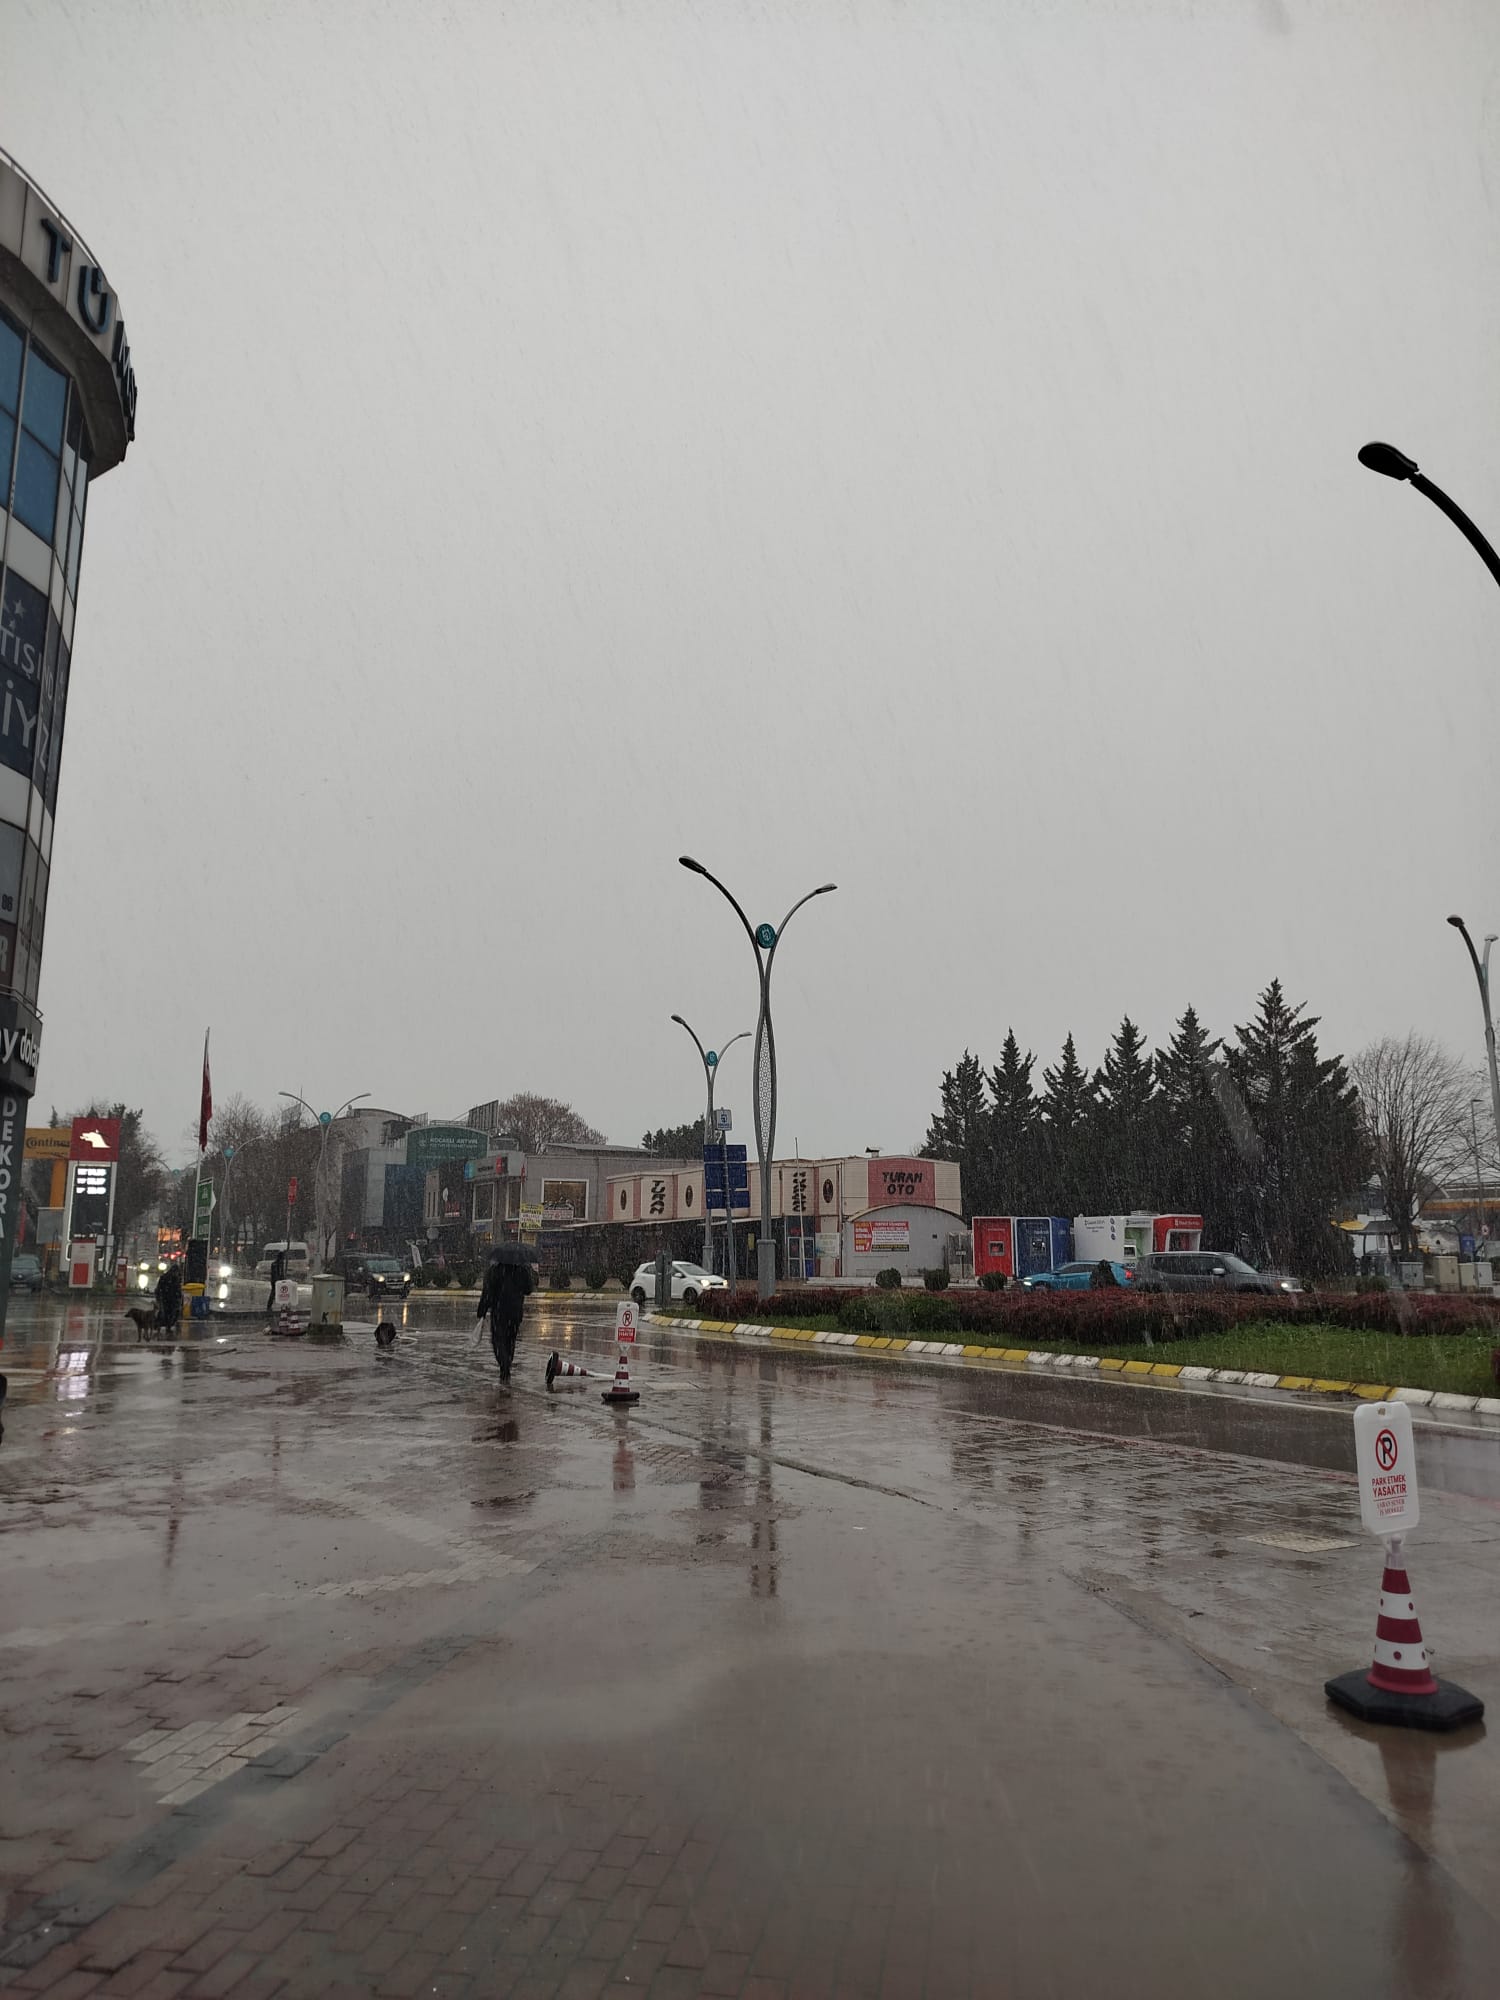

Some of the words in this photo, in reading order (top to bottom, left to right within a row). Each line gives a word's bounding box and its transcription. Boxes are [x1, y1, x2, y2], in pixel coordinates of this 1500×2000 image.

[882, 1171, 923, 1184] TURAN
[887, 1183, 914, 1195] OTO
[1372, 1483, 1407, 1498] YASAKTIR
